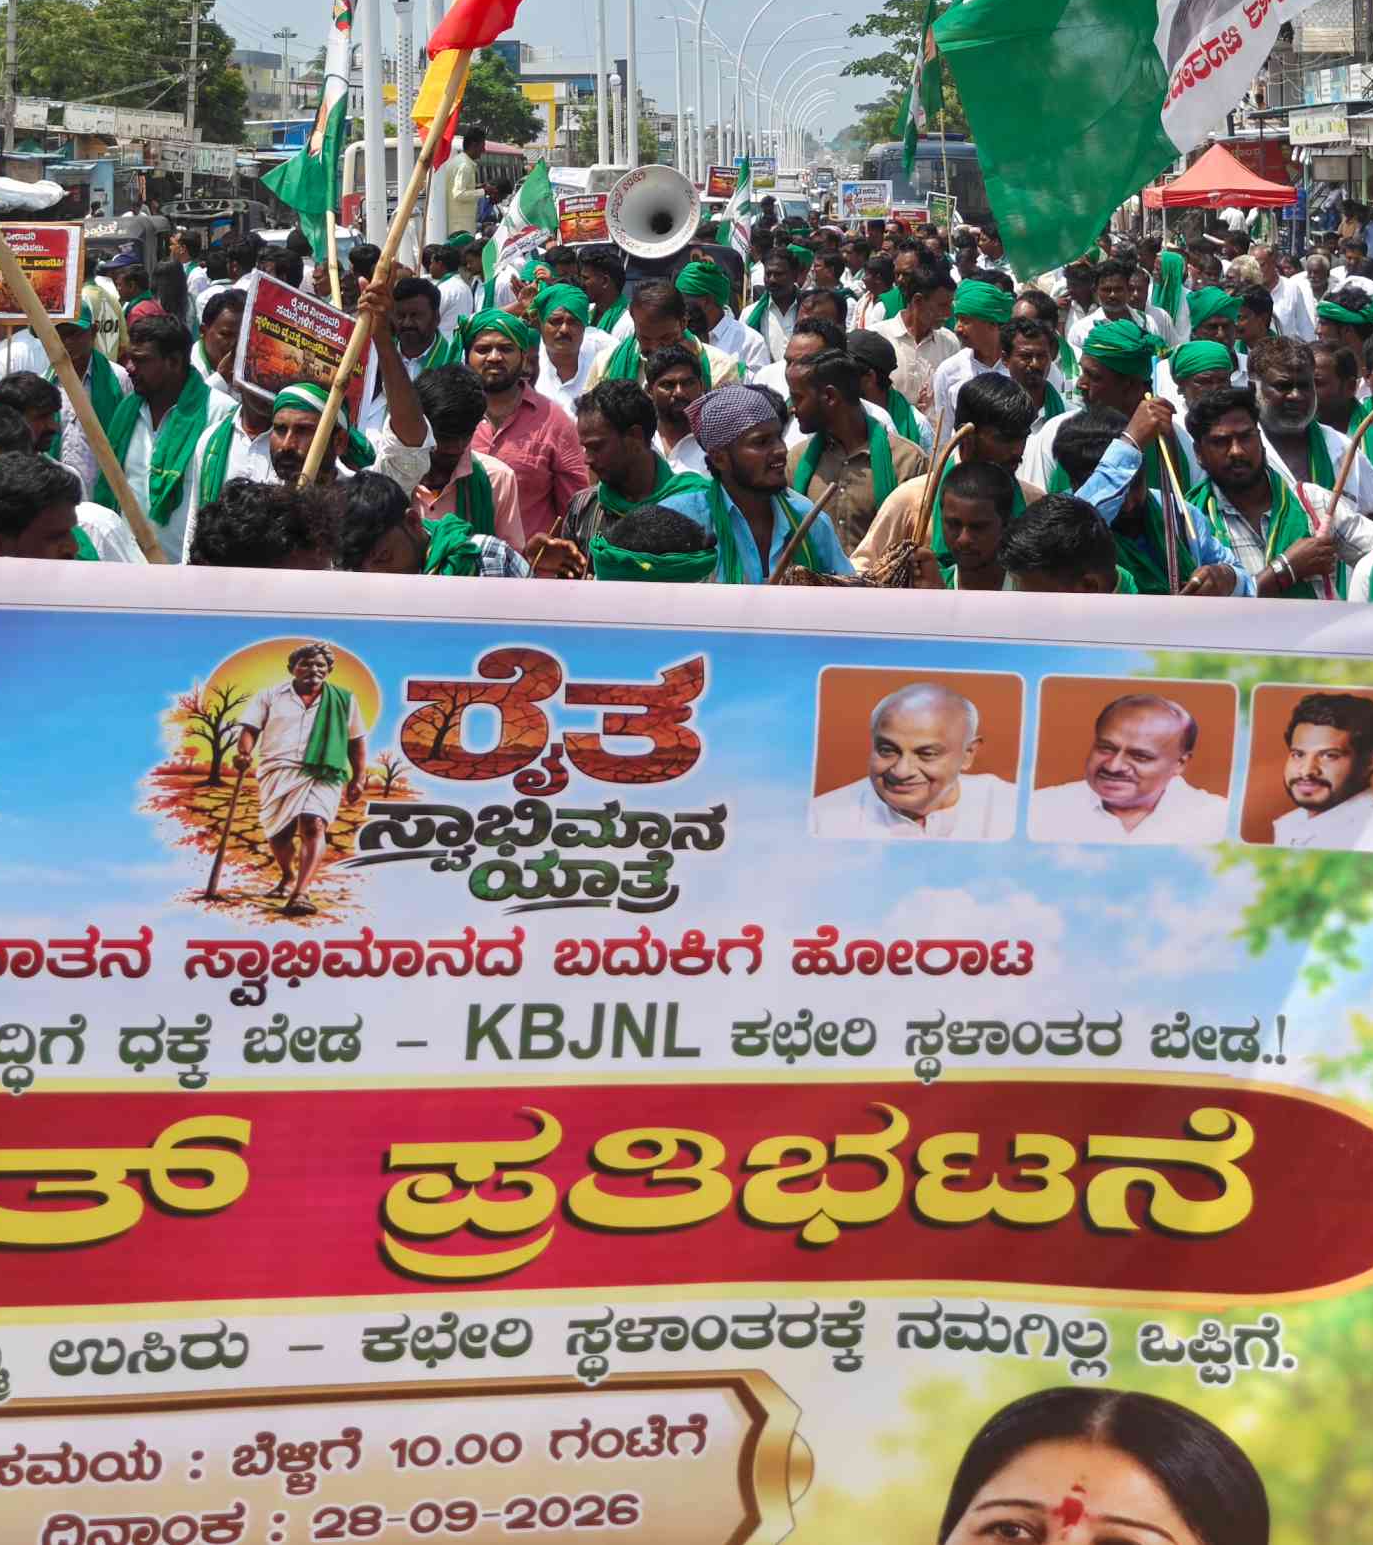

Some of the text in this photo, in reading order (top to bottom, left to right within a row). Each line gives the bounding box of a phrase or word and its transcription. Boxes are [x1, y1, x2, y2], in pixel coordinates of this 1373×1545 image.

[400, 646, 705, 797] ರೈತ
[358, 797, 728, 872] ಸ್ವಾಭಿಮಾನ
[468, 848, 680, 914] ಯಾತ್ರೆ
[185, 924, 522, 1006] ಸ್ವಾಭಿಮಾನದ
[553, 925, 763, 977] ಬದುಕಿಗೆ
[792, 925, 1034, 977] ಹೋರಾಟ
[120, 1014, 212, 1090] ಧಕ್ಕೆ
[243, 1011, 363, 1064] ಬೇಡ
[464, 1002, 701, 1061] KBJNL
[731, 1009, 878, 1066] ಕಛೇರಿ
[905, 1011, 1124, 1085] ಸ್ಥಳಾಂತರ
[381, 1101, 1257, 1280] ಪ್ರತಿಭಟನೆ
[49, 1321, 249, 1378] ಉಸಿರು
[362, 1312, 533, 1369] ಕಛೇರಿ
[567, 1301, 866, 1383] ಸ್ಥಳಾಂತರಕ್ಕೆ
[897, 1301, 1108, 1378] ನಮಗಿಲ್ಲ
[390, 1433, 524, 1468] 10.00
[549, 1413, 710, 1458] ಗಂಟೆಗೆ
[41, 1502, 246, 1545] ದಿನಾಂಕ
[313, 1493, 641, 1539] 28-09-2026
